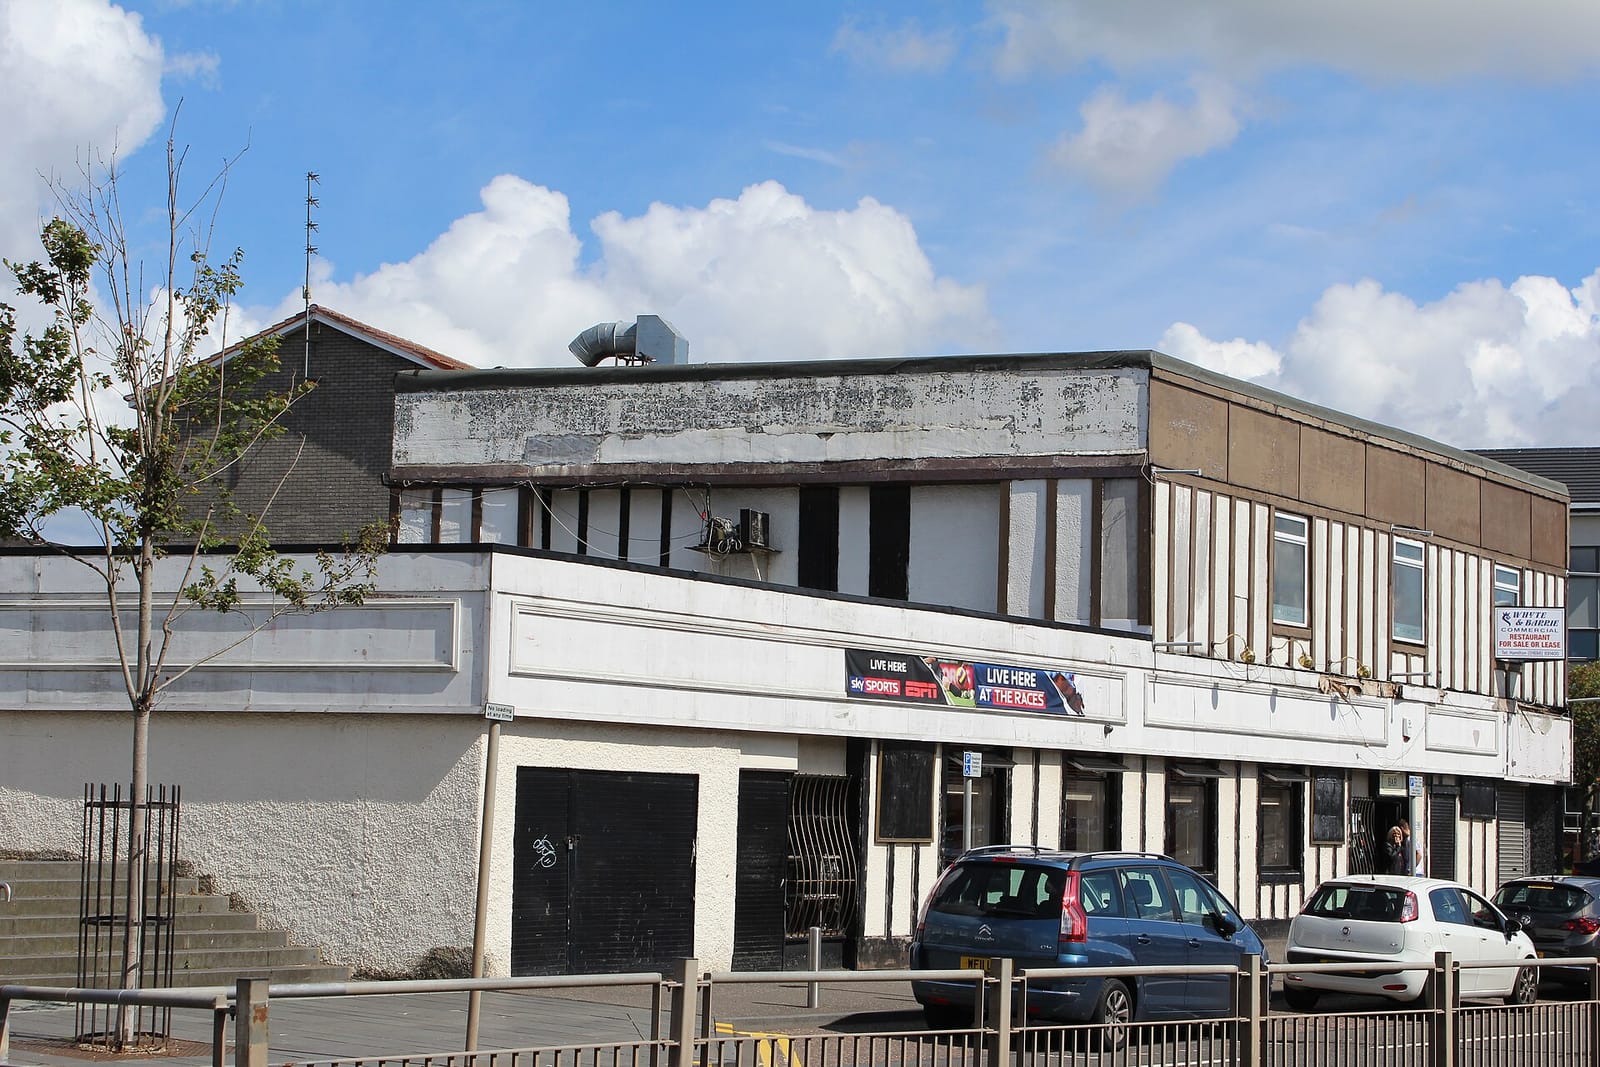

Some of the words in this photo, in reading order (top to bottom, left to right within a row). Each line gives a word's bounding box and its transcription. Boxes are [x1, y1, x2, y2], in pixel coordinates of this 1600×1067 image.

[870, 658, 887, 671] LIVE
[887, 661, 907, 673] HERE
[987, 667, 1009, 685] LIVE
[1011, 670, 1037, 688] HERE
[851, 677, 865, 692] sky
[865, 680, 899, 693] SPORTS
[905, 680, 938, 699] ESPN
[979, 687, 992, 702] AT
[993, 689, 1013, 704] THE
[1014, 691, 1044, 706] RACES
